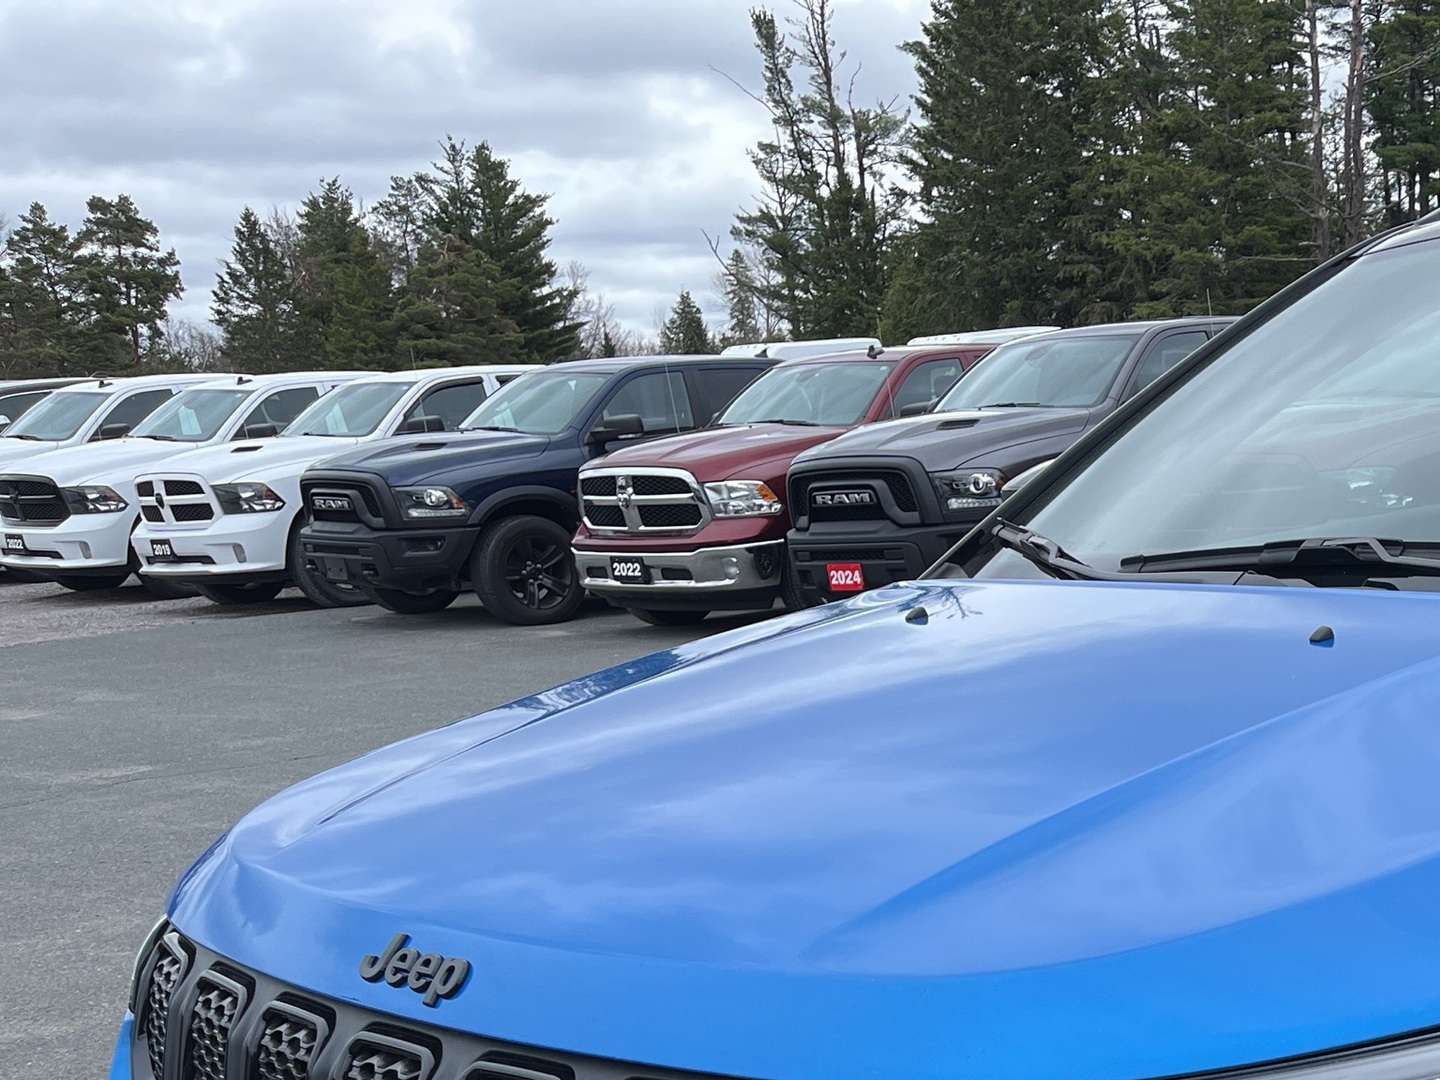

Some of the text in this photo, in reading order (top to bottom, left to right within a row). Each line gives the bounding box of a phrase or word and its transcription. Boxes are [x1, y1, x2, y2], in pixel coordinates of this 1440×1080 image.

[314, 499, 349, 508] RAM
[815, 493, 870, 504] RAM
[613, 562, 642, 576] 2022
[830, 570, 861, 584] 2024
[360, 932, 472, 1008] Jeep
